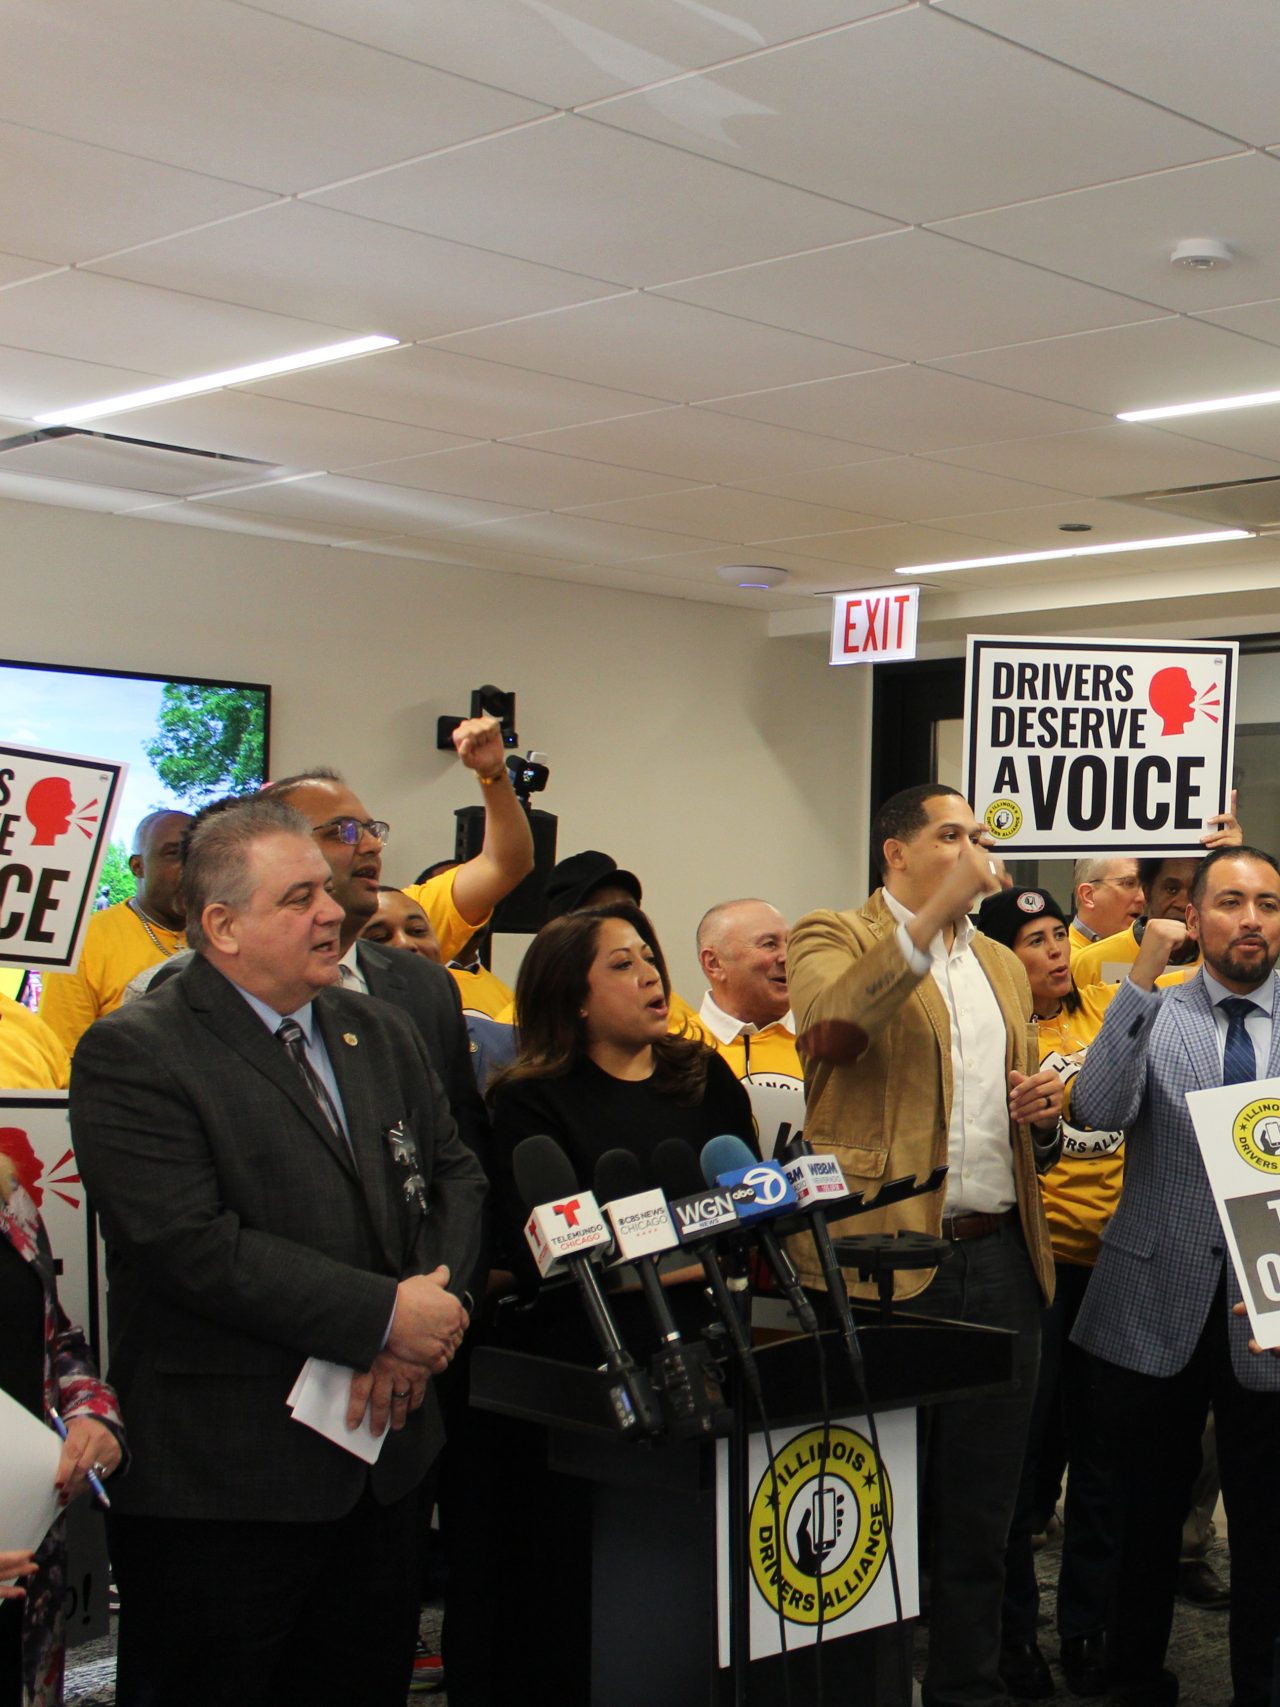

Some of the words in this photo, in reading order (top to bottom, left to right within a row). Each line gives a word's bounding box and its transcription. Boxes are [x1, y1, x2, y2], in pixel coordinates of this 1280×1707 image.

[843, 595, 910, 653] EXIT
[992, 661, 1134, 701] DRIVERS
[990, 705, 1148, 749] DESERVE
[992, 755, 1020, 793] A
[1027, 754, 1205, 831] VOICE
[1239, 1136, 1278, 1170] DRIVERS
[807, 1162, 838, 1175] WBBM
[732, 1186, 755, 1200] abc
[641, 1207, 665, 1219] NEWS
[676, 1192, 735, 1225] WGN
[551, 1224, 603, 1246] TELEMUNDO
[620, 1216, 668, 1235] CHICAGO
[699, 1218, 719, 1228] NEWS
[560, 1234, 600, 1250] CHICAGO
[822, 1502, 884, 1611] ALLIANCE
